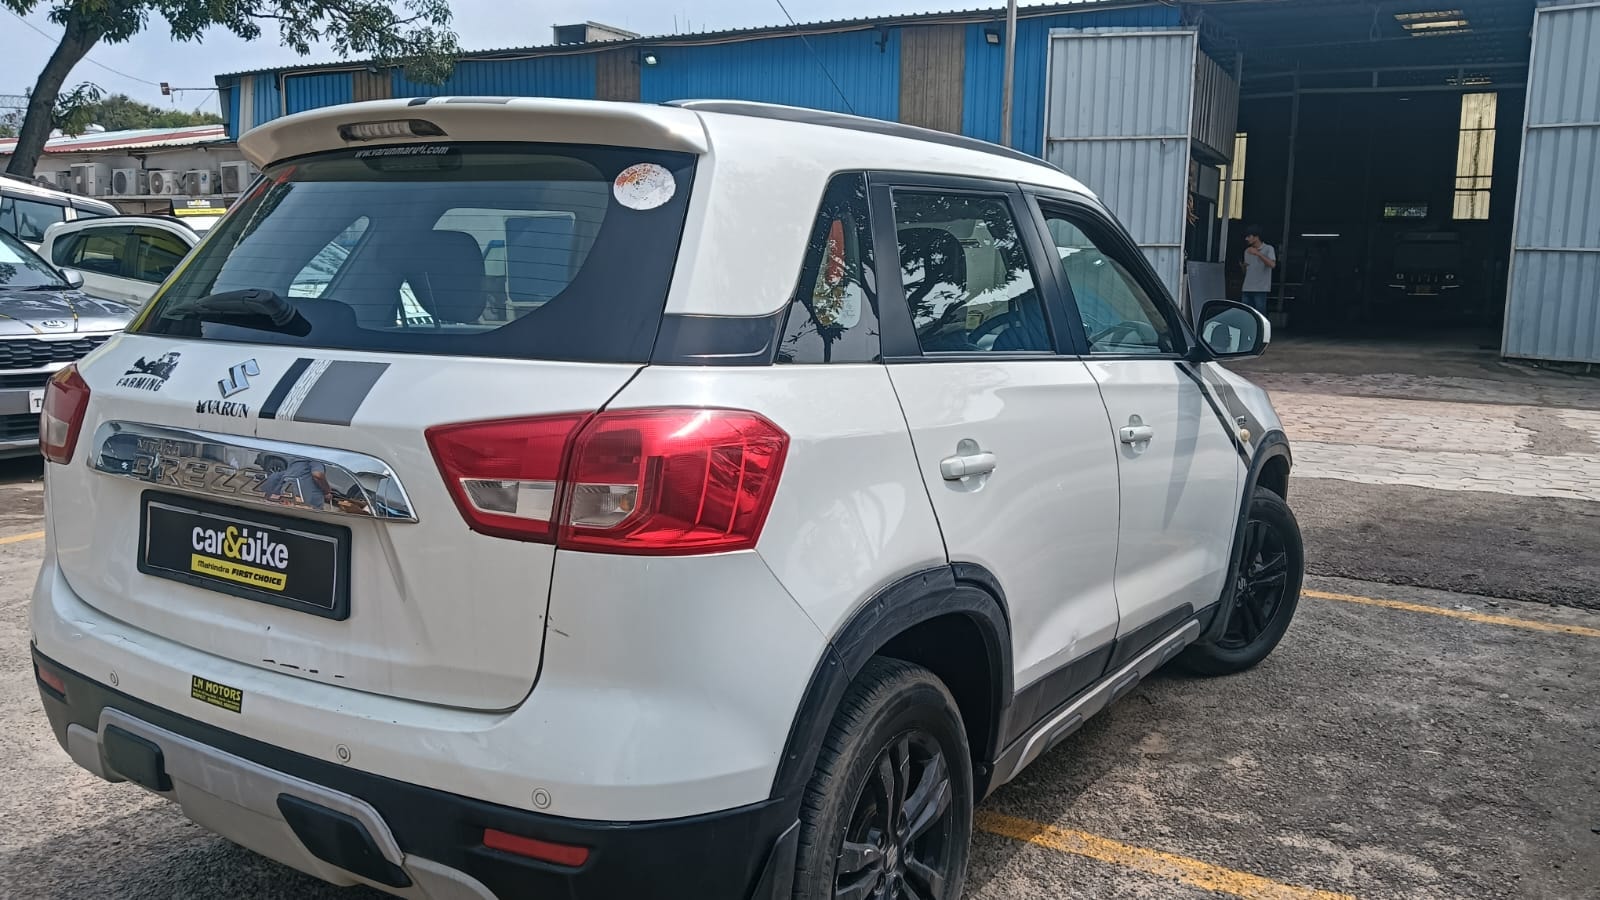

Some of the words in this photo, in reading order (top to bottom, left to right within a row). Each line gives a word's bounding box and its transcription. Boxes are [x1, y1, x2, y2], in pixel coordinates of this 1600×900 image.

[116, 376, 165, 392] FARMING
[206, 400, 250, 418] VARUN
[132, 453, 305, 503] BREZZA
[192, 525, 288, 569] car&bike
[197, 560, 230, 574] Mahindra
[231, 567, 253, 580] FIRST
[253, 573, 283, 586] CHOICE
[205, 681, 241, 701] MOTORS
